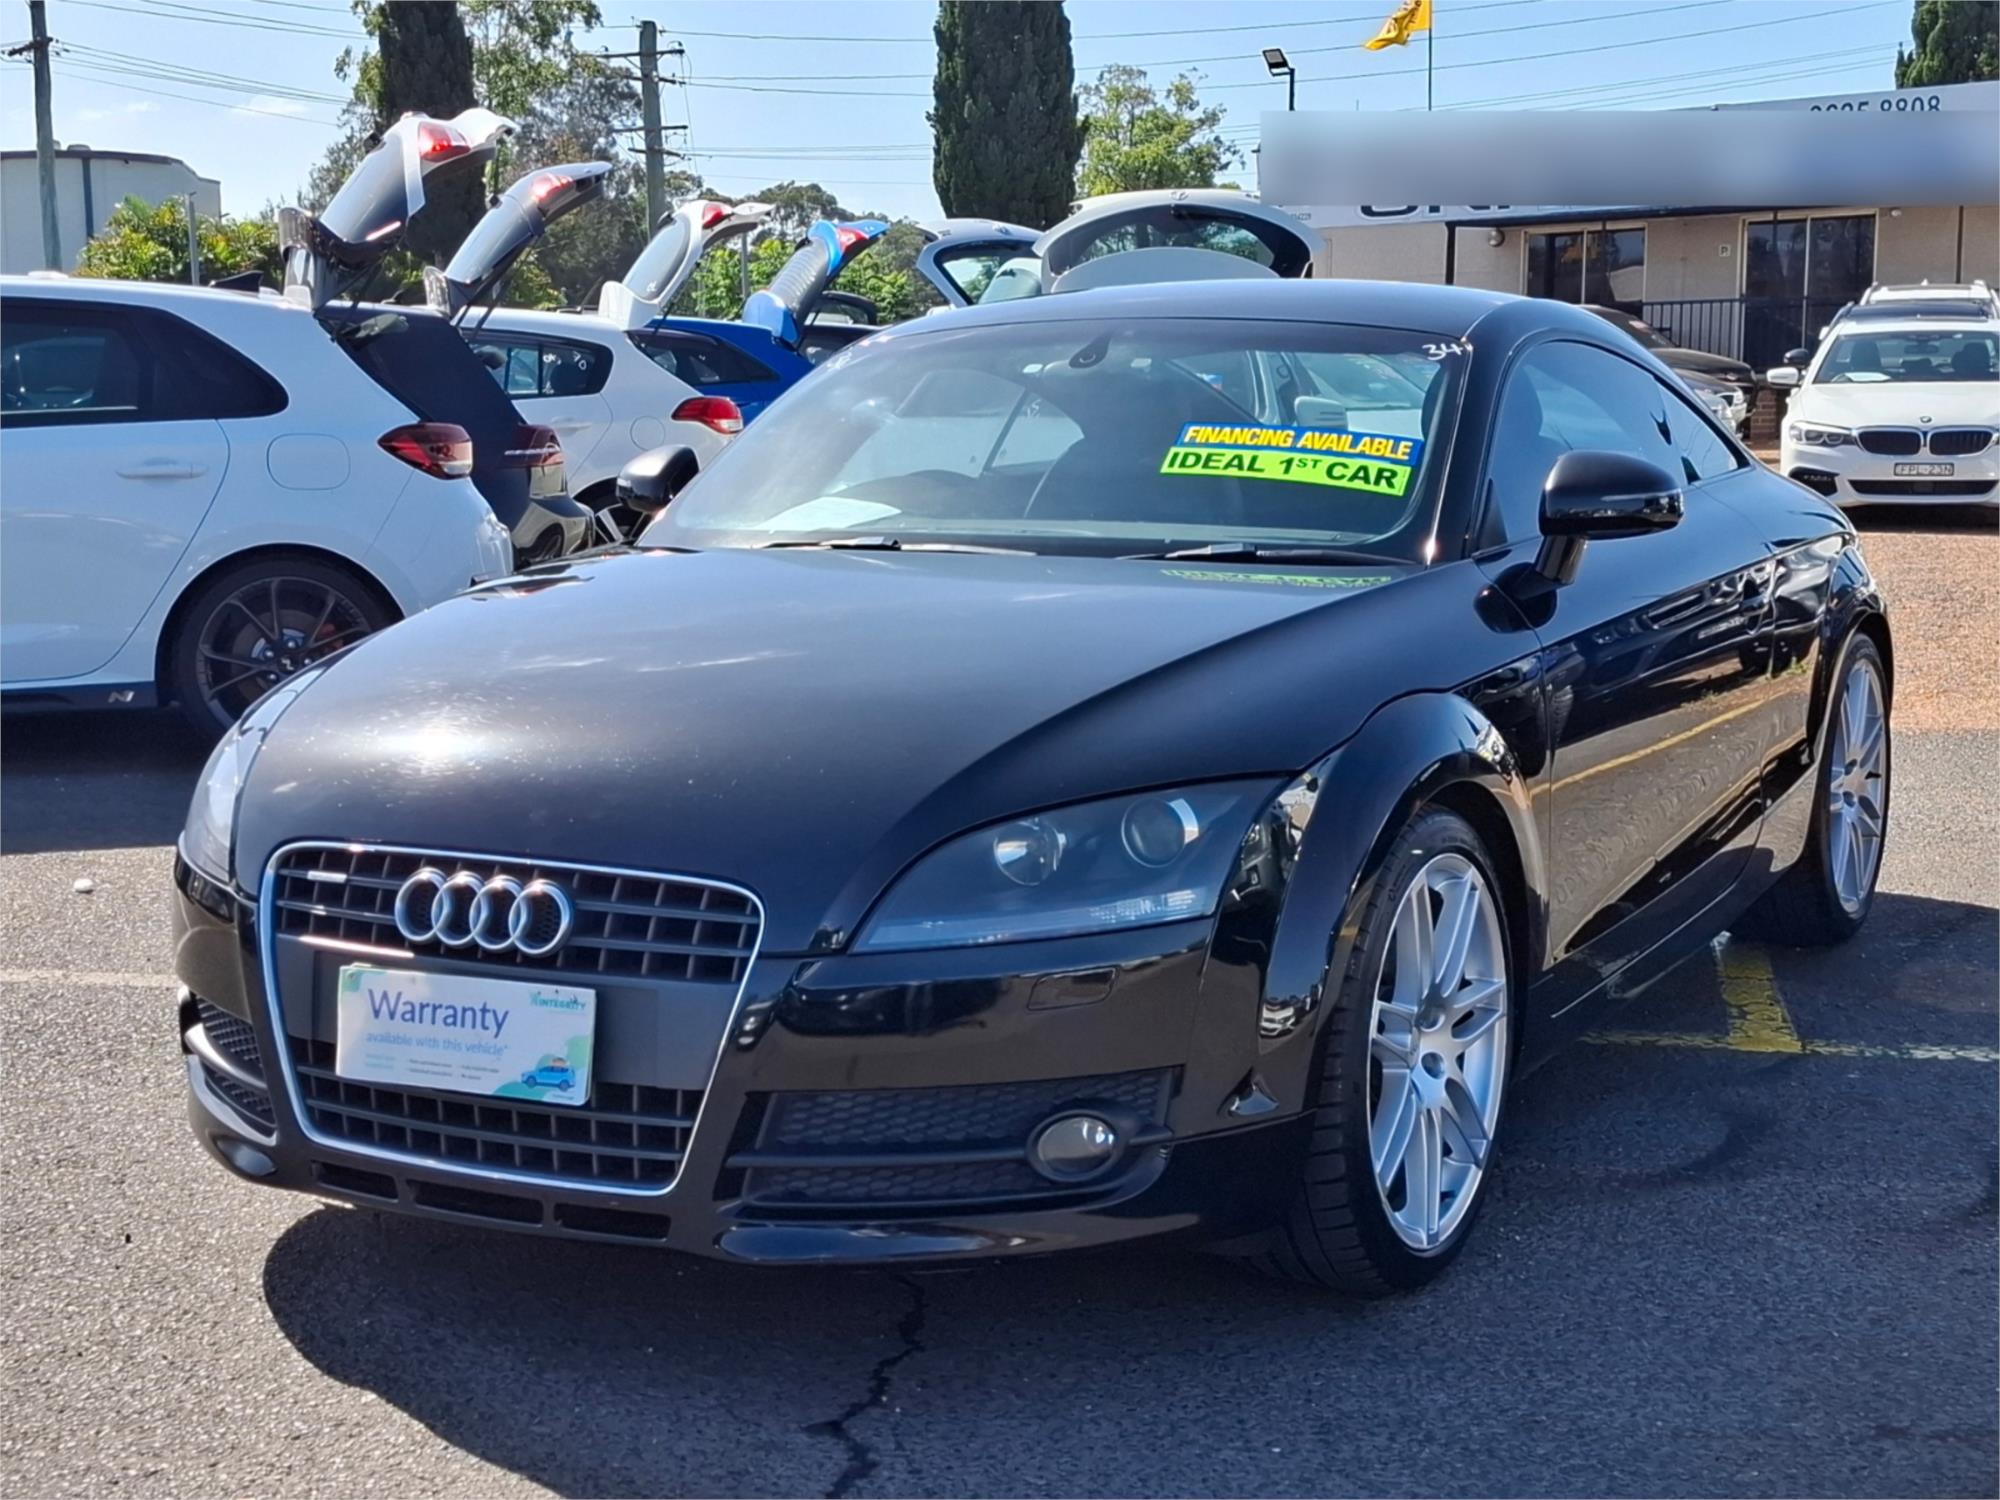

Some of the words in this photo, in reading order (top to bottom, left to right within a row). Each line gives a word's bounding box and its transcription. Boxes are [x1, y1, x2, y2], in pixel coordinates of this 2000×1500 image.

[1183, 425, 1295, 448] FINANCING
[1297, 431, 1413, 460] AVAILABLE
[1167, 451, 1265, 474] IDEAL
[1279, 457, 1322, 475] 1ST
[1326, 462, 1398, 489] CAR
[368, 989, 508, 1039] Warranty
[366, 1032, 413, 1046] available
[415, 1036, 440, 1049] with
[442, 1038, 462, 1052] this
